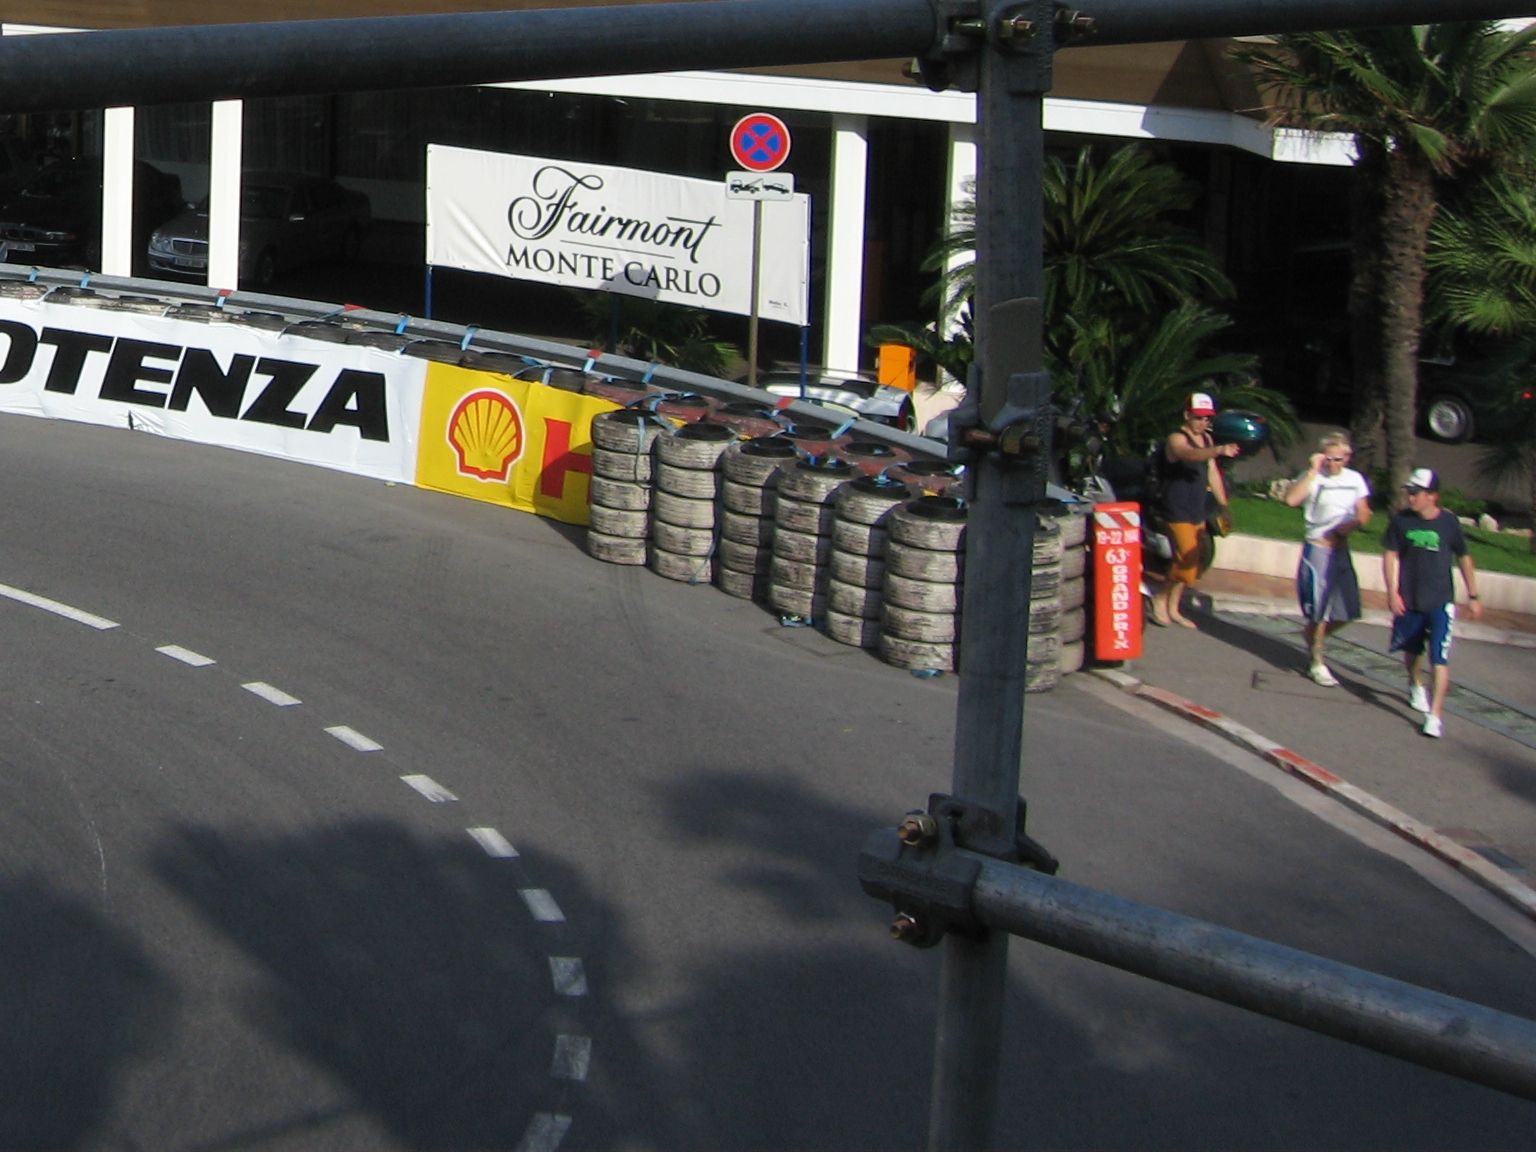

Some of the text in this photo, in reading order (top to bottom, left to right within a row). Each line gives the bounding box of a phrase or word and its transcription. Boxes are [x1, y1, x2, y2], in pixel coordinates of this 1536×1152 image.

[508, 165, 722, 264] Fairmont
[506, 243, 721, 298] MONTE CARLO
